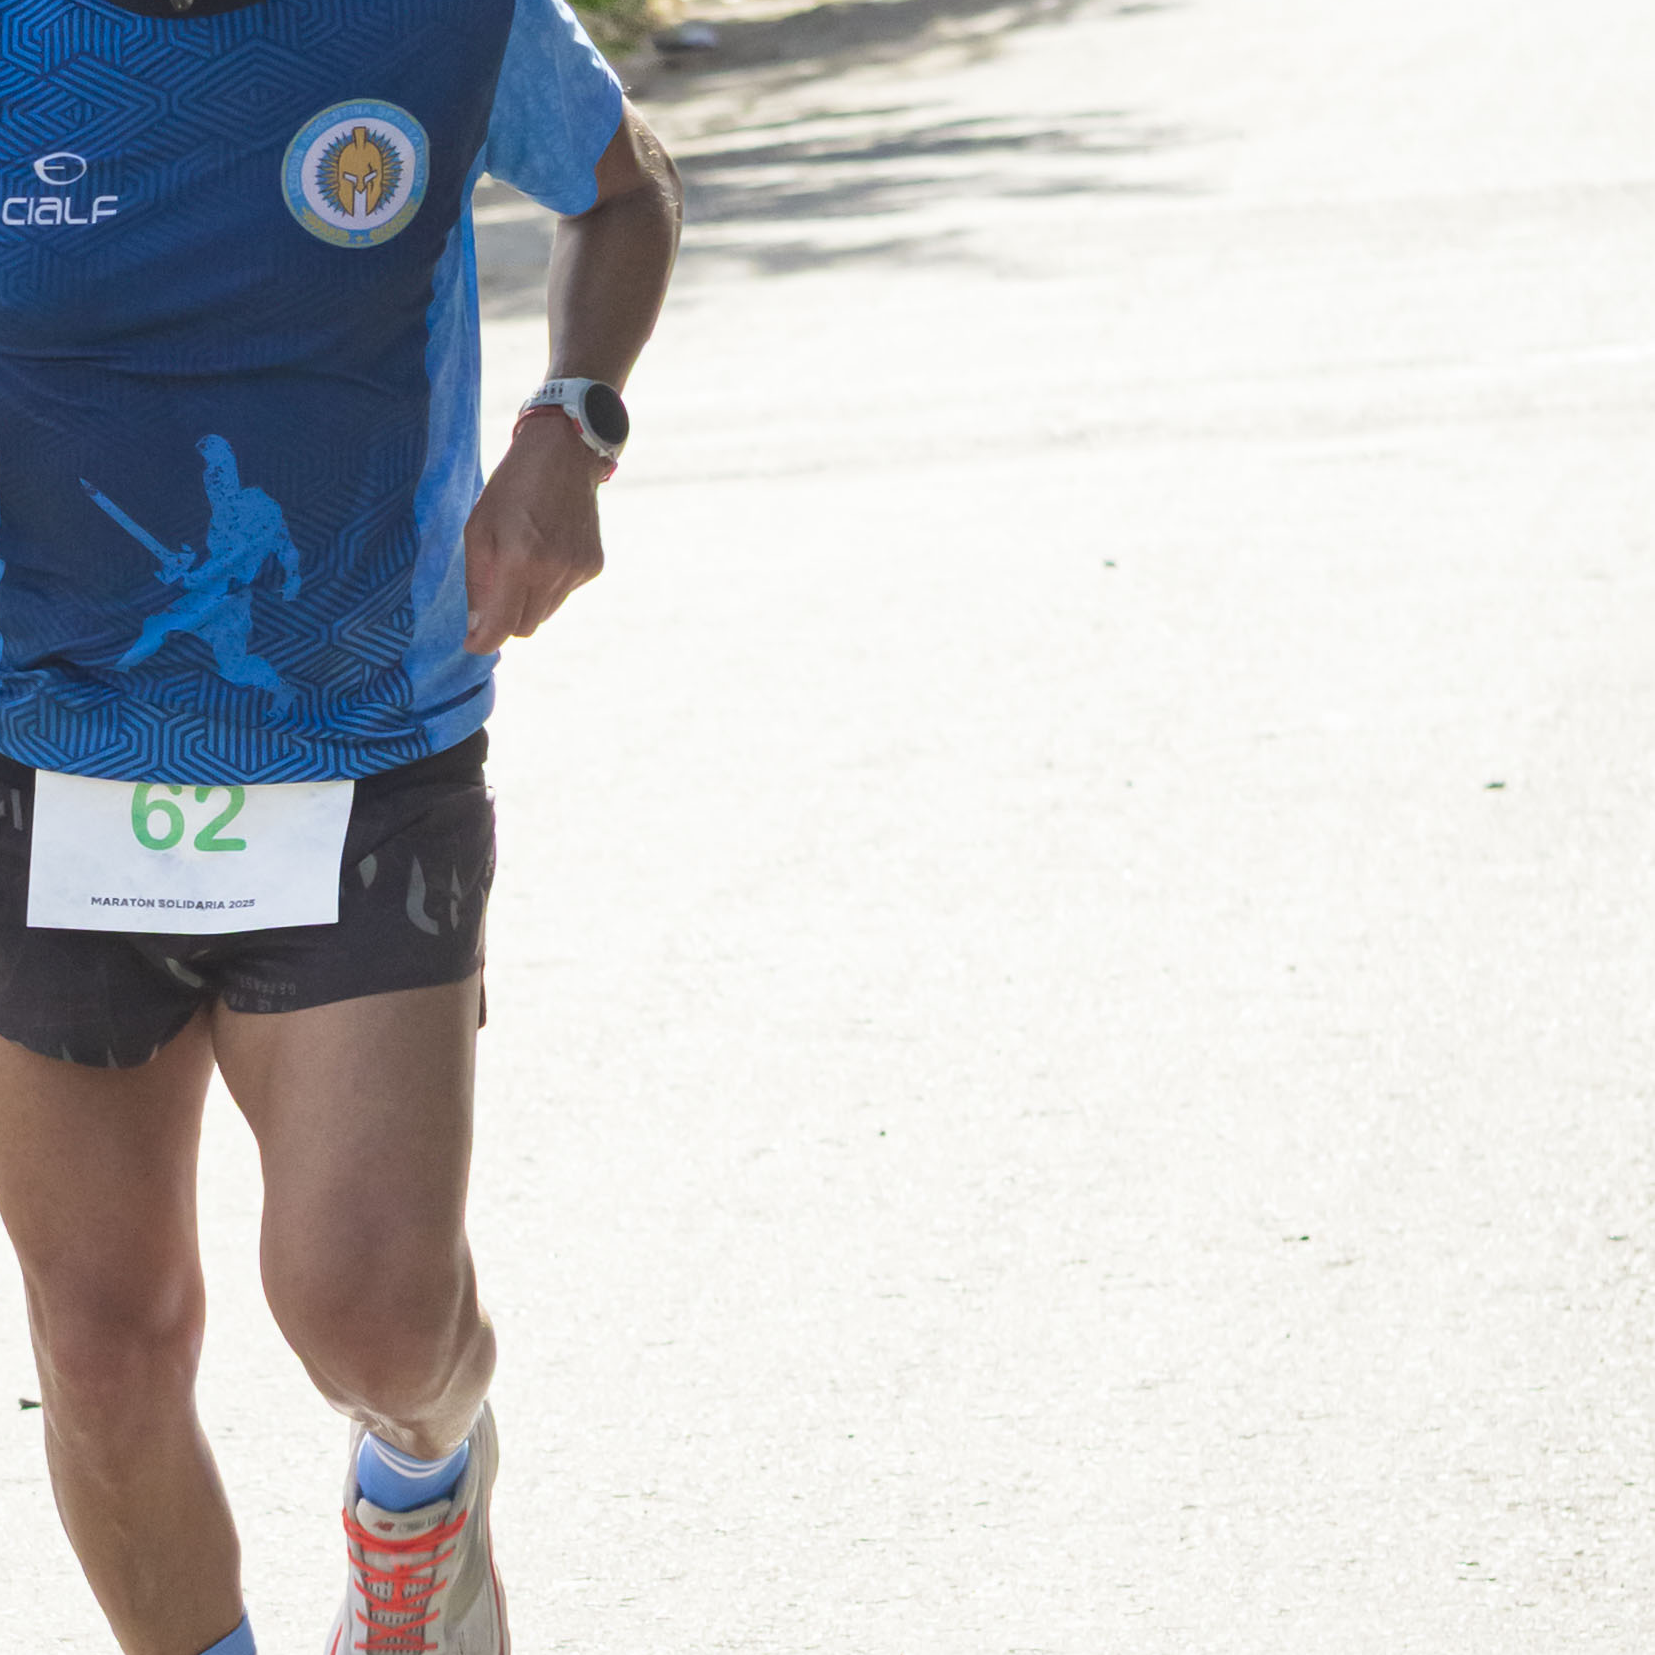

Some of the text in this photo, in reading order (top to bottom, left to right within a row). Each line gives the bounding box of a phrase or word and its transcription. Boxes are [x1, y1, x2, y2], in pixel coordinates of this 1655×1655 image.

[131, 783, 247, 851] 62
[159, 899, 225, 910] SOLIDARIA
[229, 899, 255, 909] 2025
